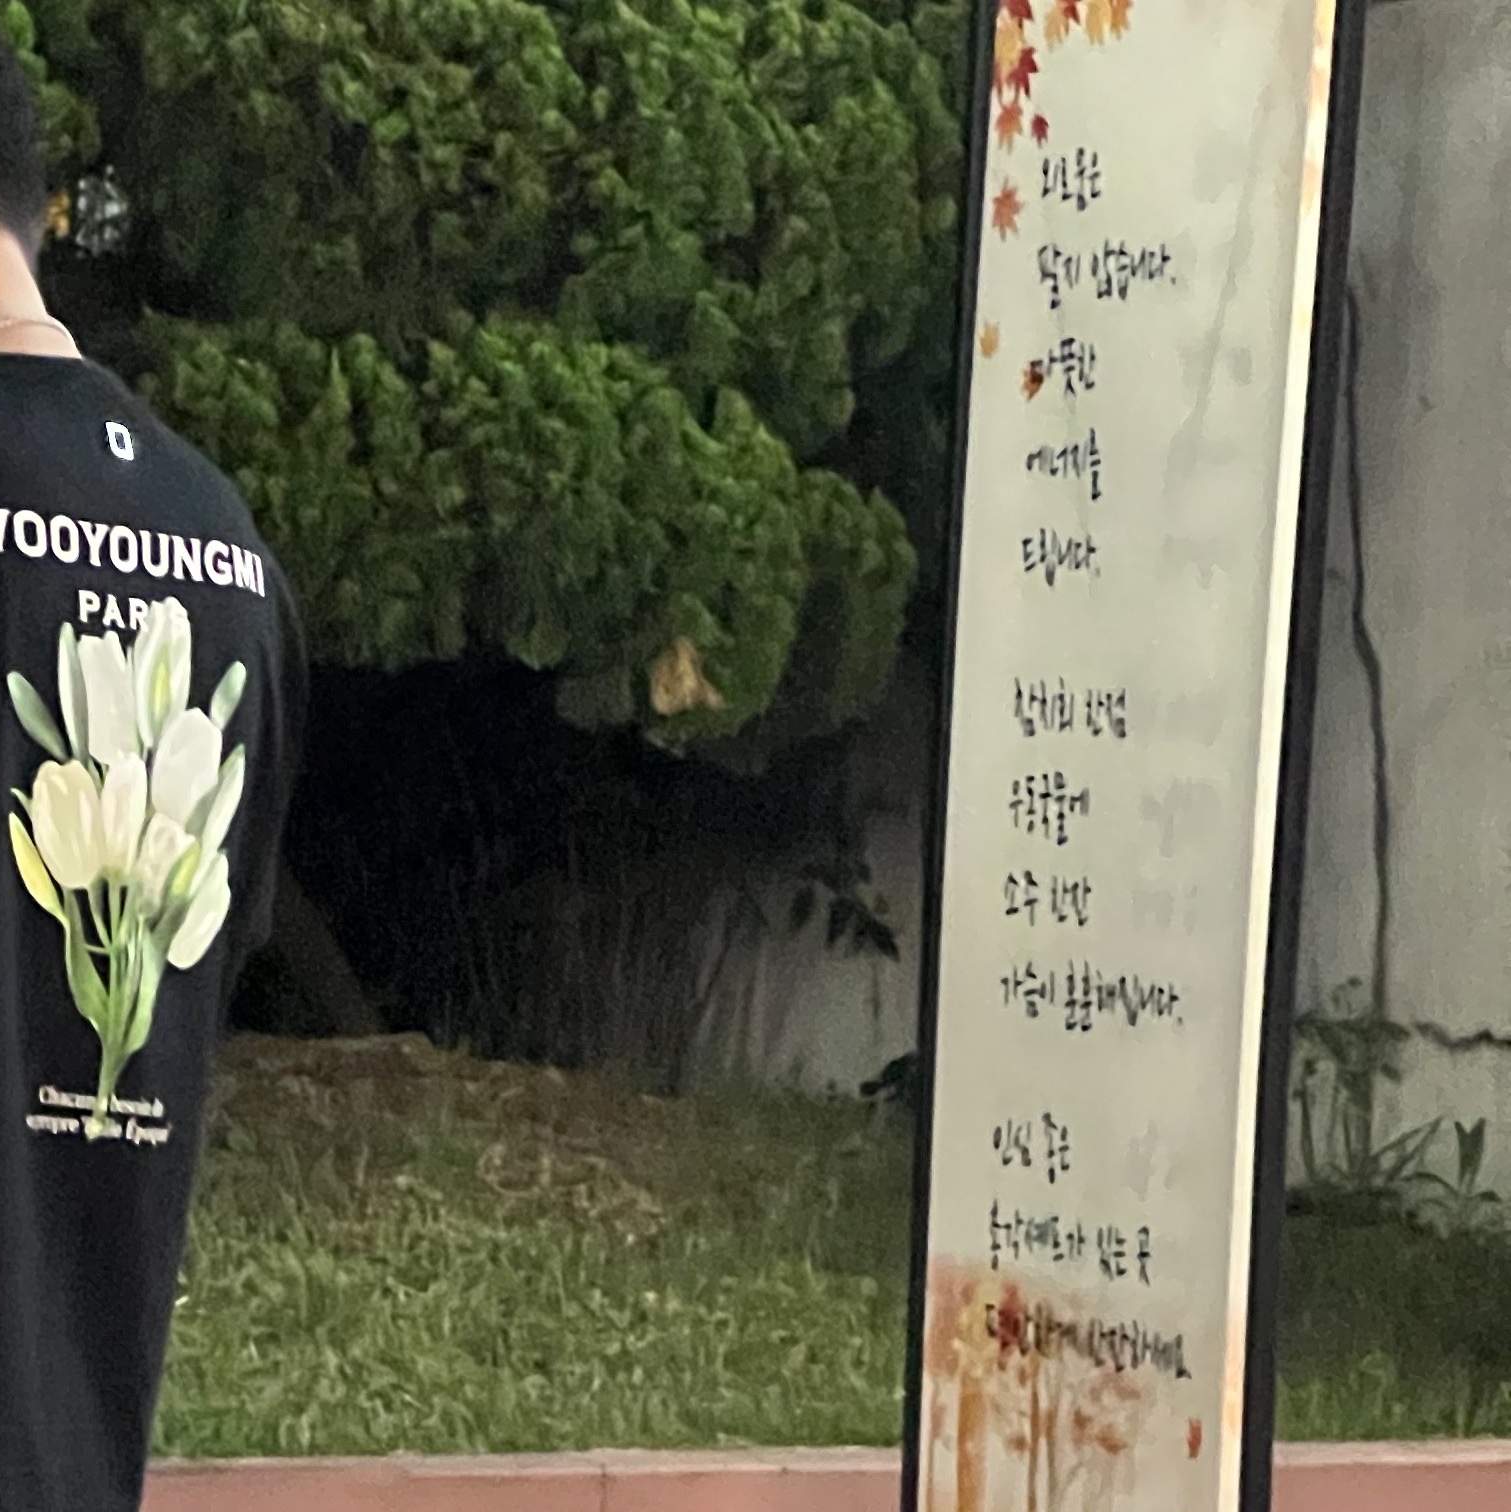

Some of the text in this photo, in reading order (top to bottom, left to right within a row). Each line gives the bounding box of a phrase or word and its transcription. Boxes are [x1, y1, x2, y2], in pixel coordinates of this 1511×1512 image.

[1028, 337, 1096, 396] 따뜻한
[1026, 427, 1102, 500] 에너지를
[78, 590, 188, 637] PAR
[1009, 771, 1090, 845] 우동국물에
[1004, 870, 1092, 927] 소주 한잔
[1000, 961, 1056, 1017] 가슴이
[993, 1112, 1070, 1184] 인심 좋은
[1096, 1224, 1127, 1281] 있는
[1137, 1226, 1151, 1287] 곳
